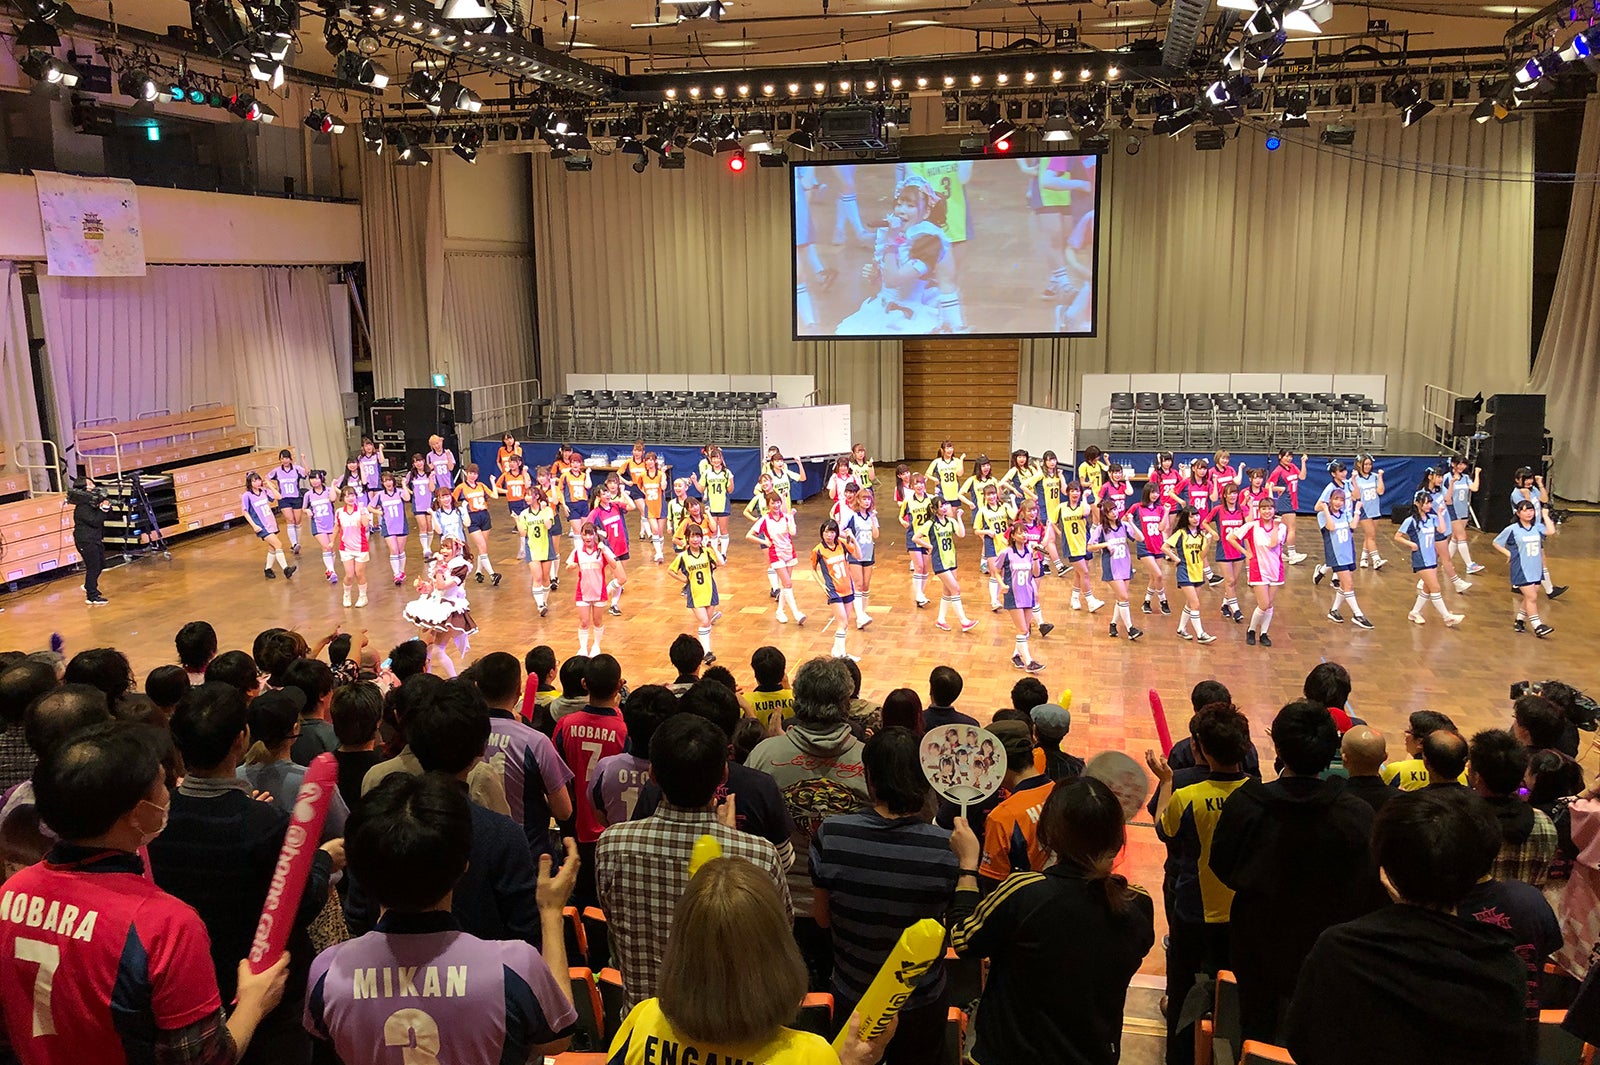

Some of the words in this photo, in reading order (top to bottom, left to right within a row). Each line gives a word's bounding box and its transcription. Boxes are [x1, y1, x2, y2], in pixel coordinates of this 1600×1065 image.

[943, 472, 955, 483] 38
[284, 483, 295, 494] 10
[418, 485, 425, 496] 3
[511, 485, 522, 497] 10
[711, 483, 723, 495] 14
[1050, 487, 1059, 499] 18
[1458, 489, 1465, 501] 8
[316, 504, 330, 517] 22
[388, 505, 399, 518] 11
[533, 525, 541, 538] 3
[610, 523, 619, 538] 7
[993, 520, 1008, 535] 93
[1071, 522, 1079, 535] 8
[1336, 528, 1349, 543] 10
[1525, 542, 1540, 557] 15
[696, 570, 705, 585] 9
[570, 725, 616, 743] NOBARA
[581, 741, 603, 782] 7
[0, 890, 98, 942] NOBARA
[14, 936, 60, 1038] 7
[353, 965, 468, 1000] MIKAN
